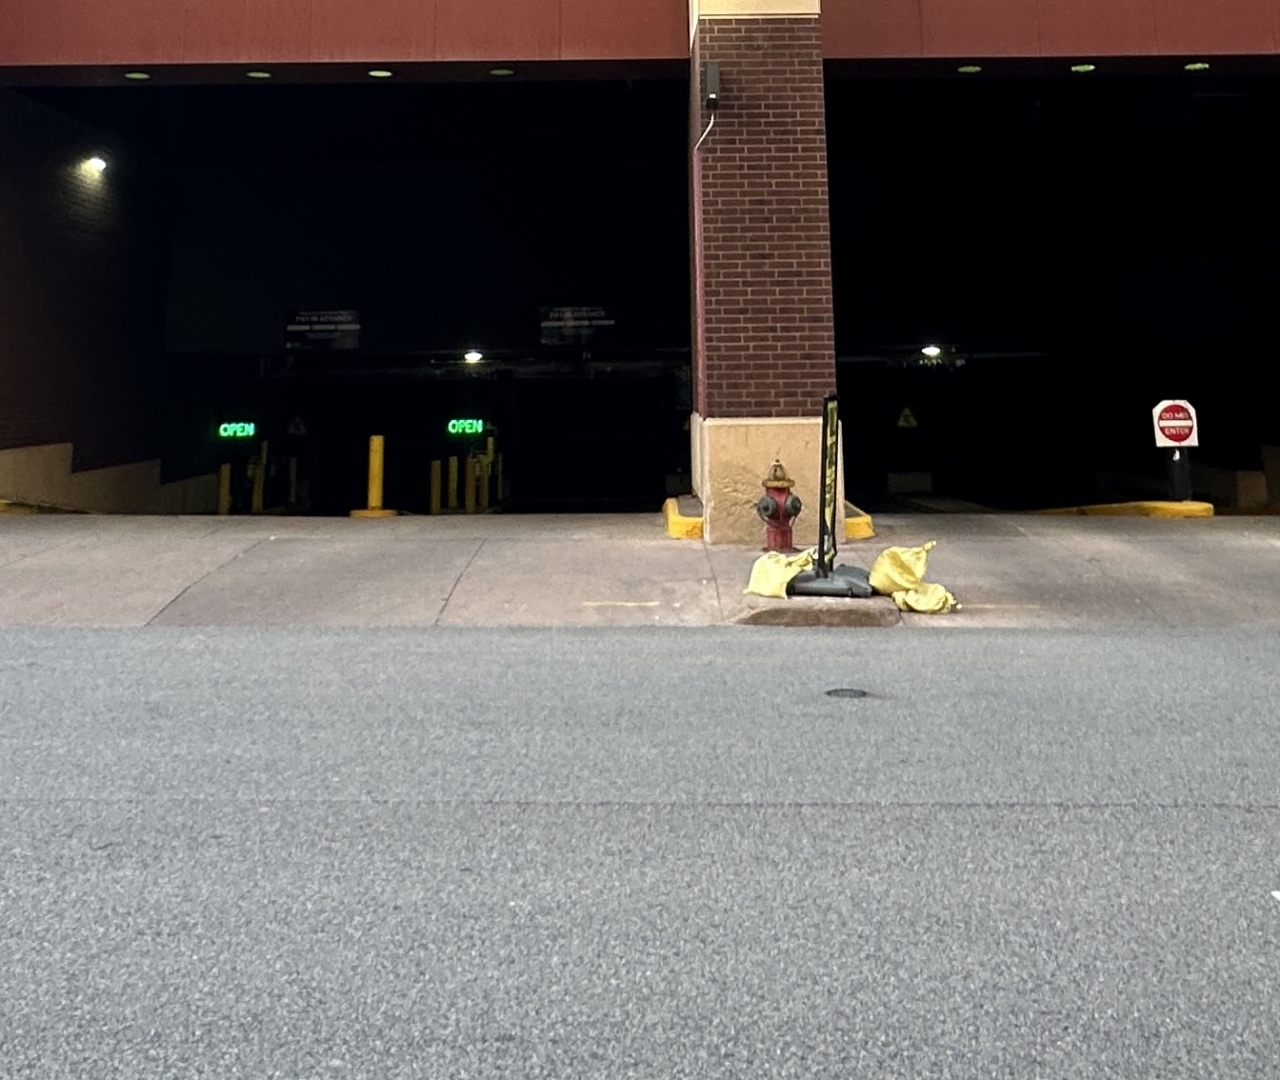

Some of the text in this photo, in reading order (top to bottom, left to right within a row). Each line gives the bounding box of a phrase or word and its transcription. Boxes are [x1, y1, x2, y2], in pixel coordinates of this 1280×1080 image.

[1161, 412, 1189, 420] DO NOT
[219, 422, 255, 437] OPEN
[448, 419, 483, 433] OPEN
[1164, 427, 1190, 435] ENTER
